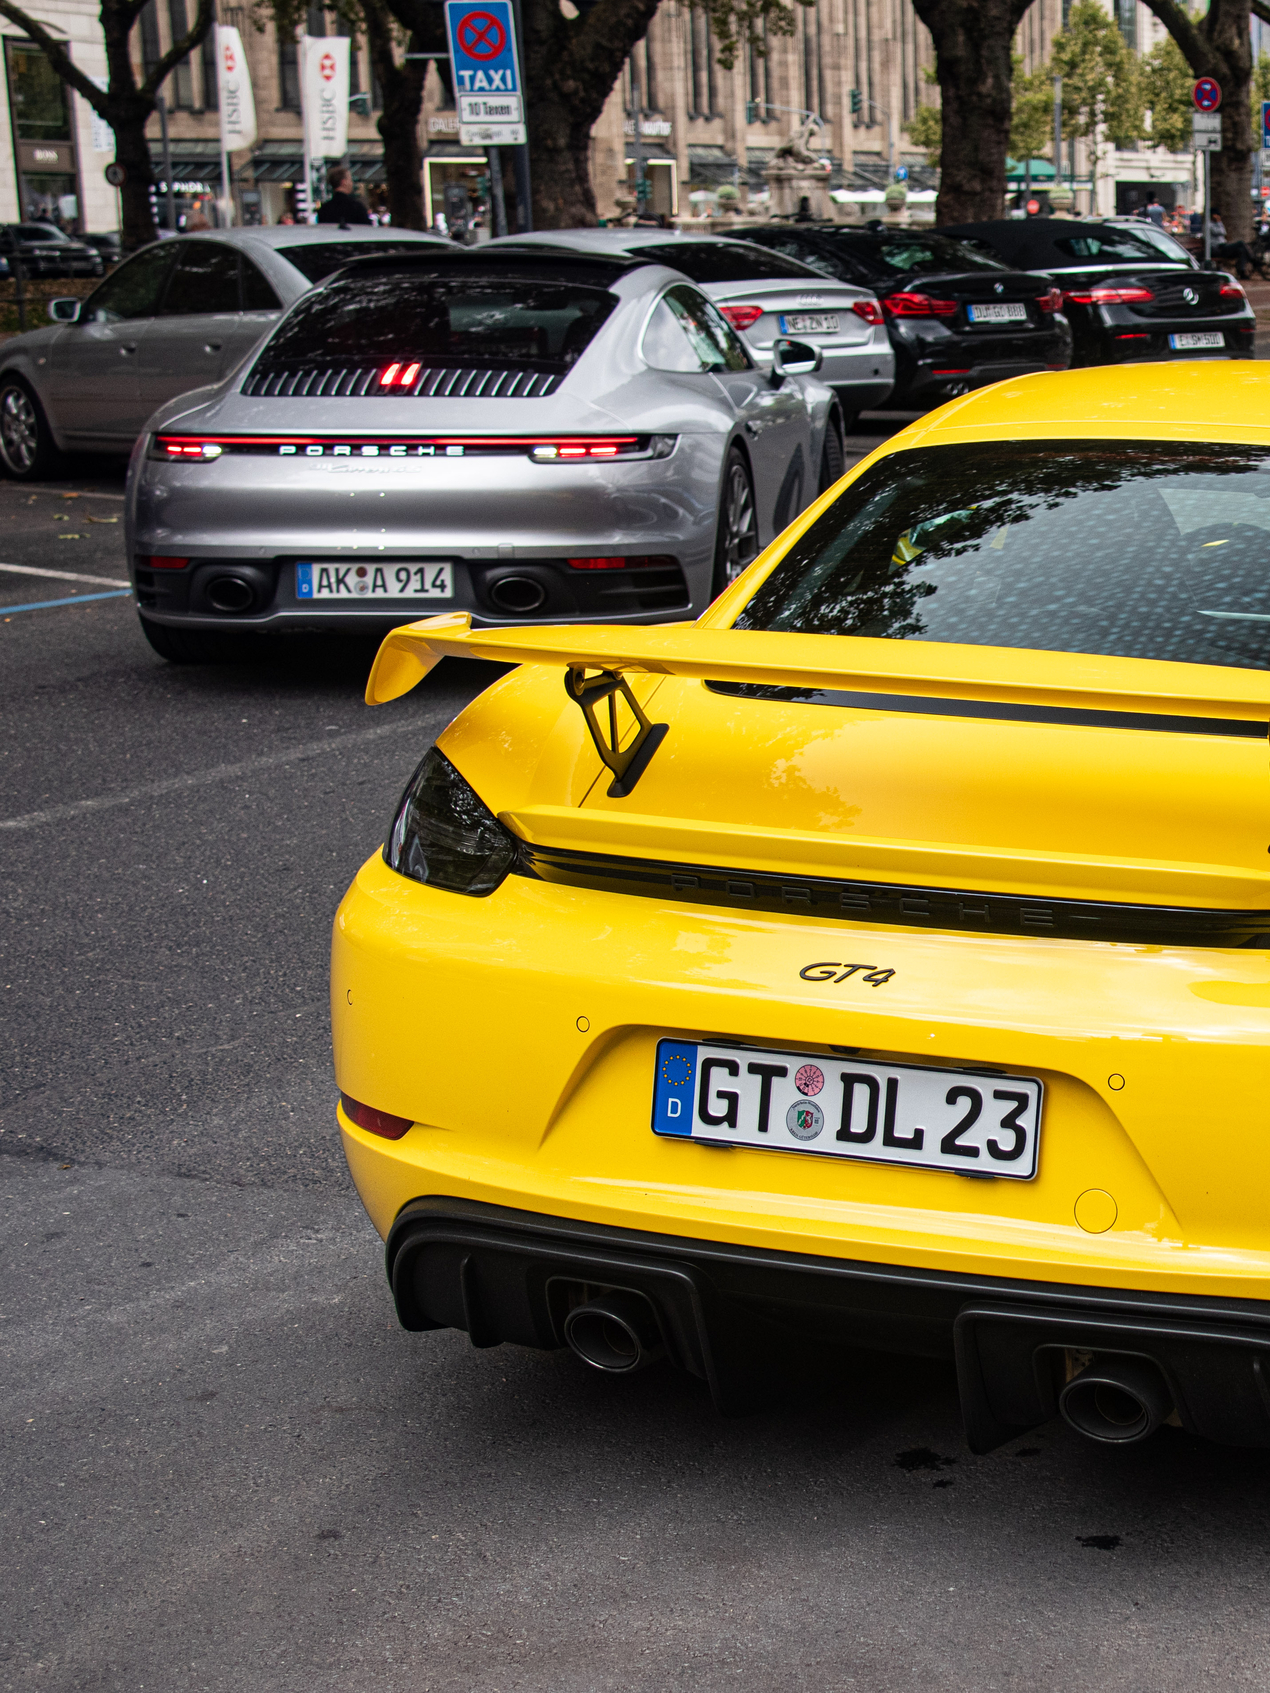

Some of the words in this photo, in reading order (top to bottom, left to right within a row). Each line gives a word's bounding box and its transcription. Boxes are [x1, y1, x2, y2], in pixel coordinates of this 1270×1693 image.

[458, 69, 513, 91] TAXI
[226, 79, 242, 134] HSBC
[320, 87, 337, 140] HSBC
[159, 181, 211, 193] SPHORA
[279, 445, 465, 456] PORSCHE
[317, 567, 353, 594] AK
[371, 567, 388, 594] A
[395, 567, 448, 594] 914
[671, 873, 1055, 928] PORSCHE
[799, 961, 897, 988] GT4
[667, 1097, 682, 1118] D
[698, 1056, 789, 1133] GT
[835, 1071, 925, 1151] DL
[940, 1085, 1031, 1162] 23
